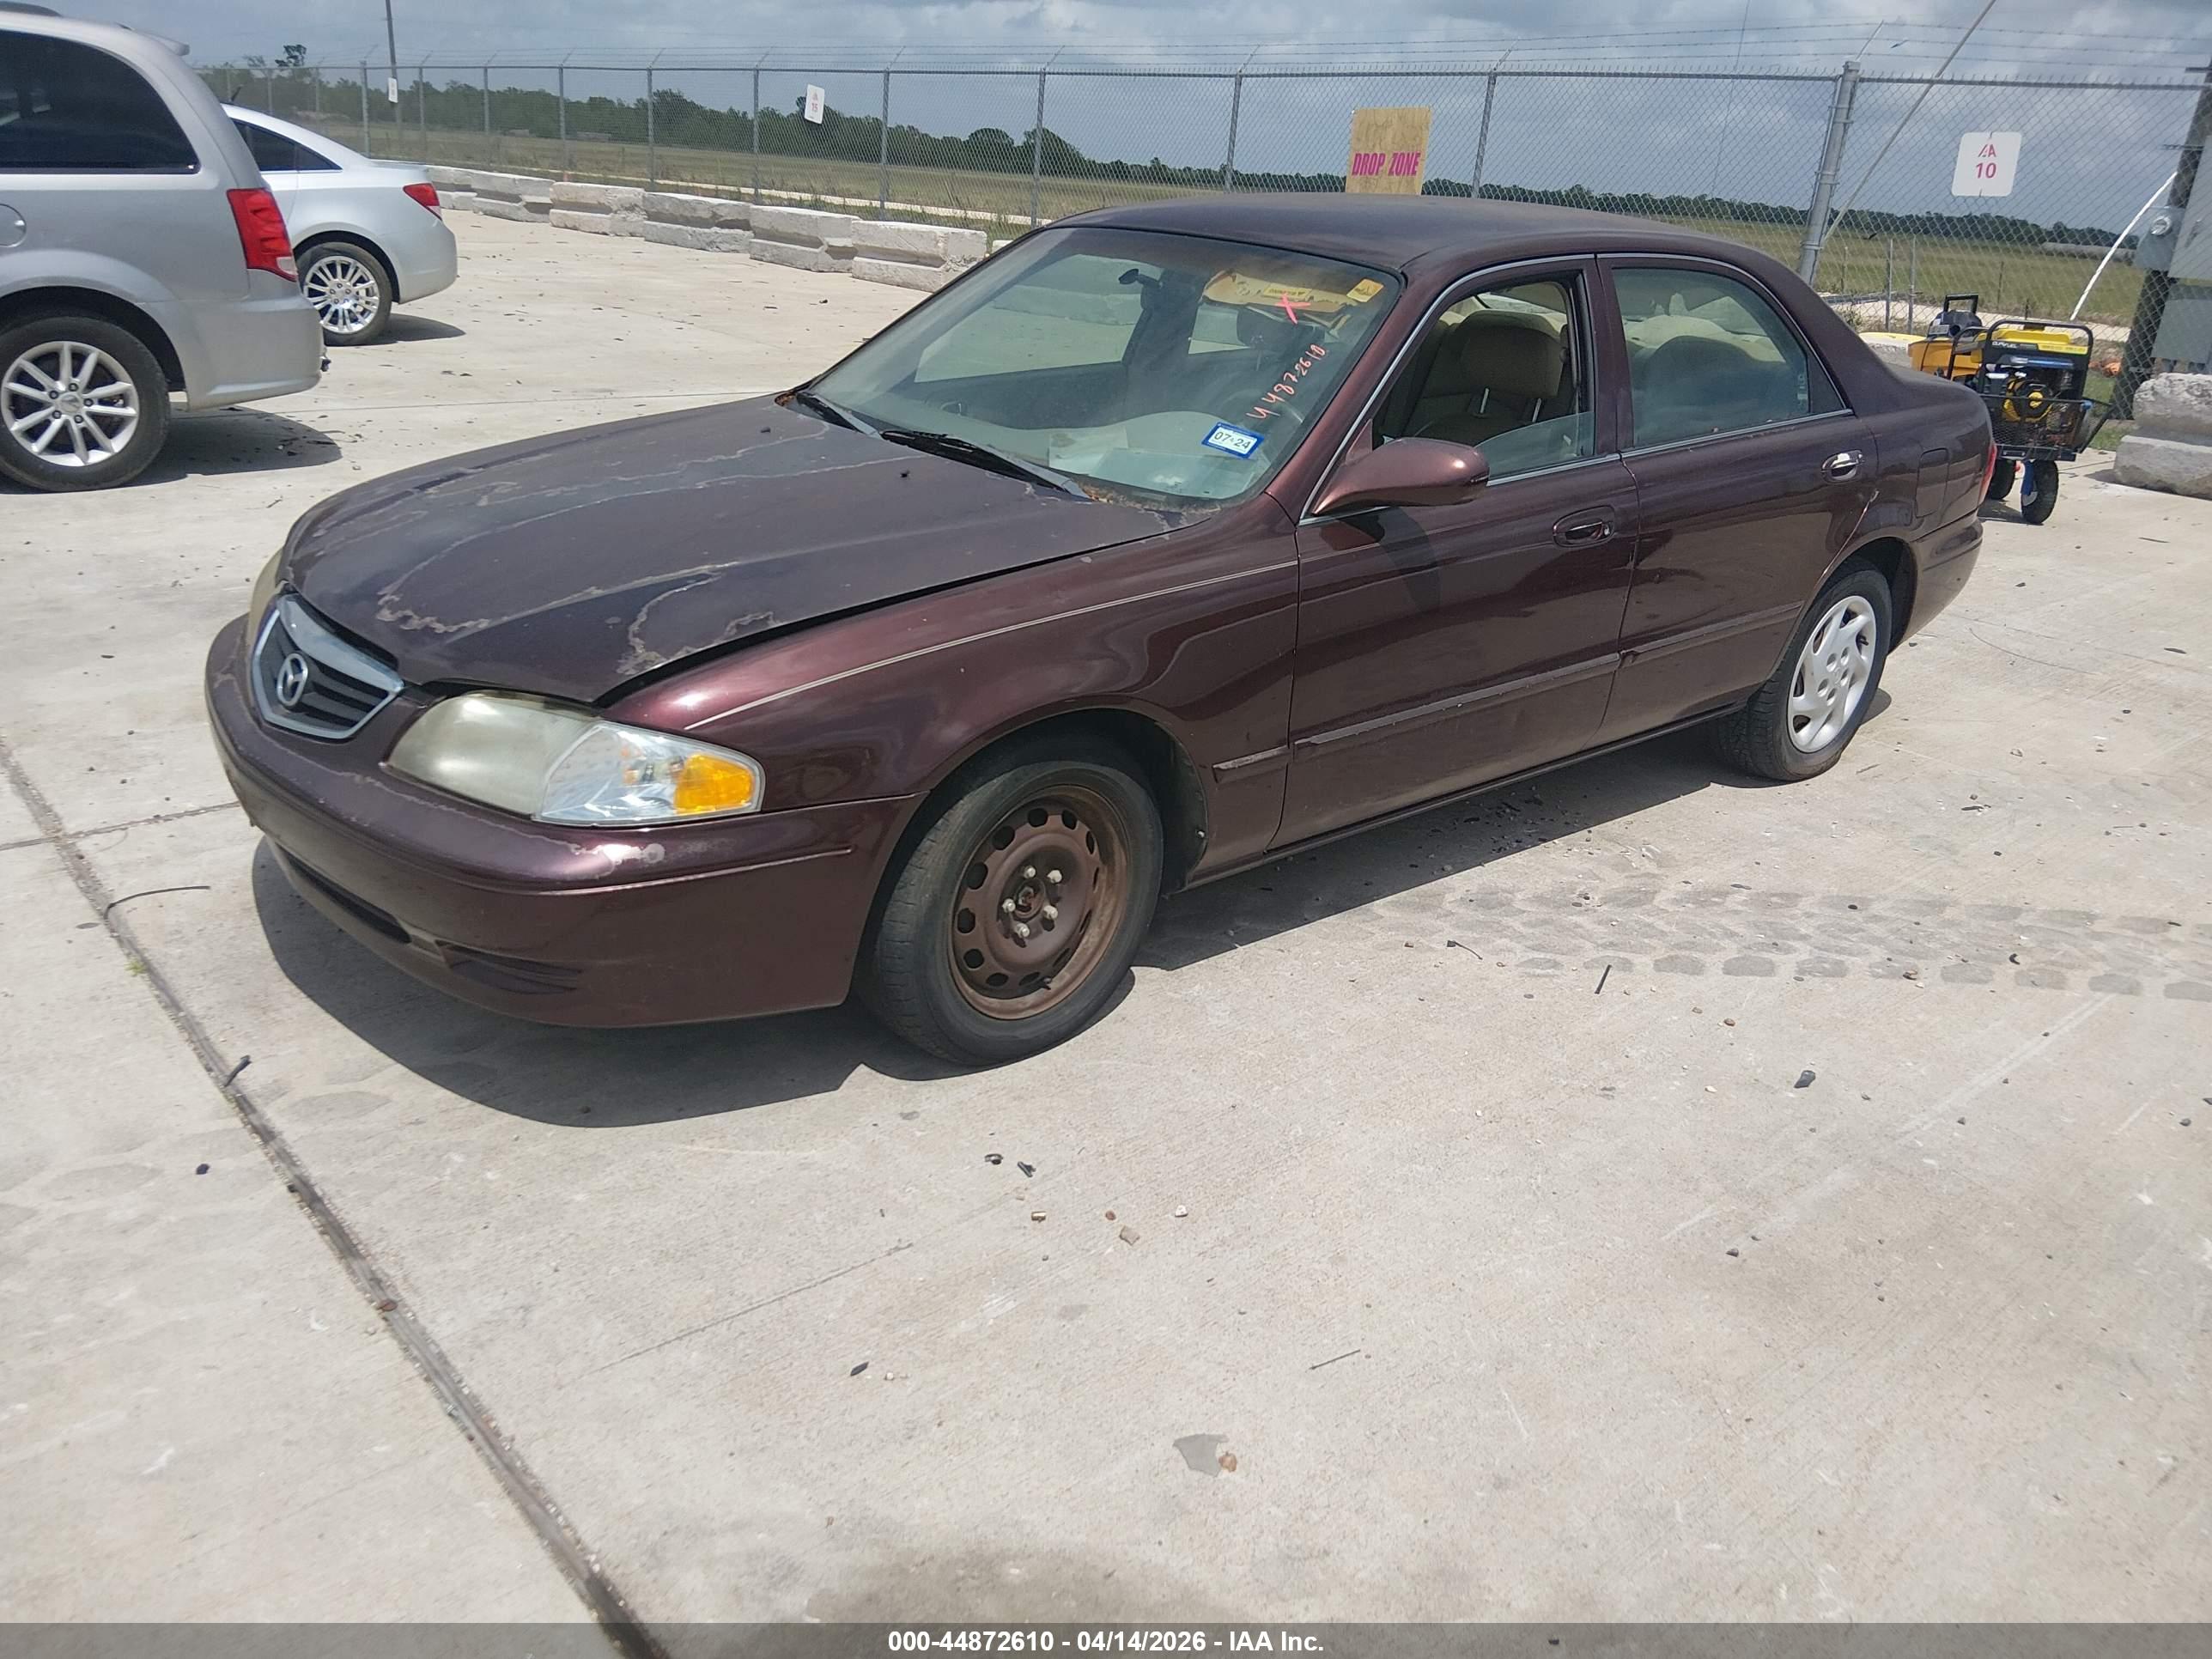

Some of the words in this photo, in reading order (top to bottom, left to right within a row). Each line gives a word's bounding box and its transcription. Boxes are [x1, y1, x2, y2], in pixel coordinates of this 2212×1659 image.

[1352, 152, 1386, 176] DROP
[1388, 151, 1421, 176] ZONE
[1975, 162, 1996, 179] 10
